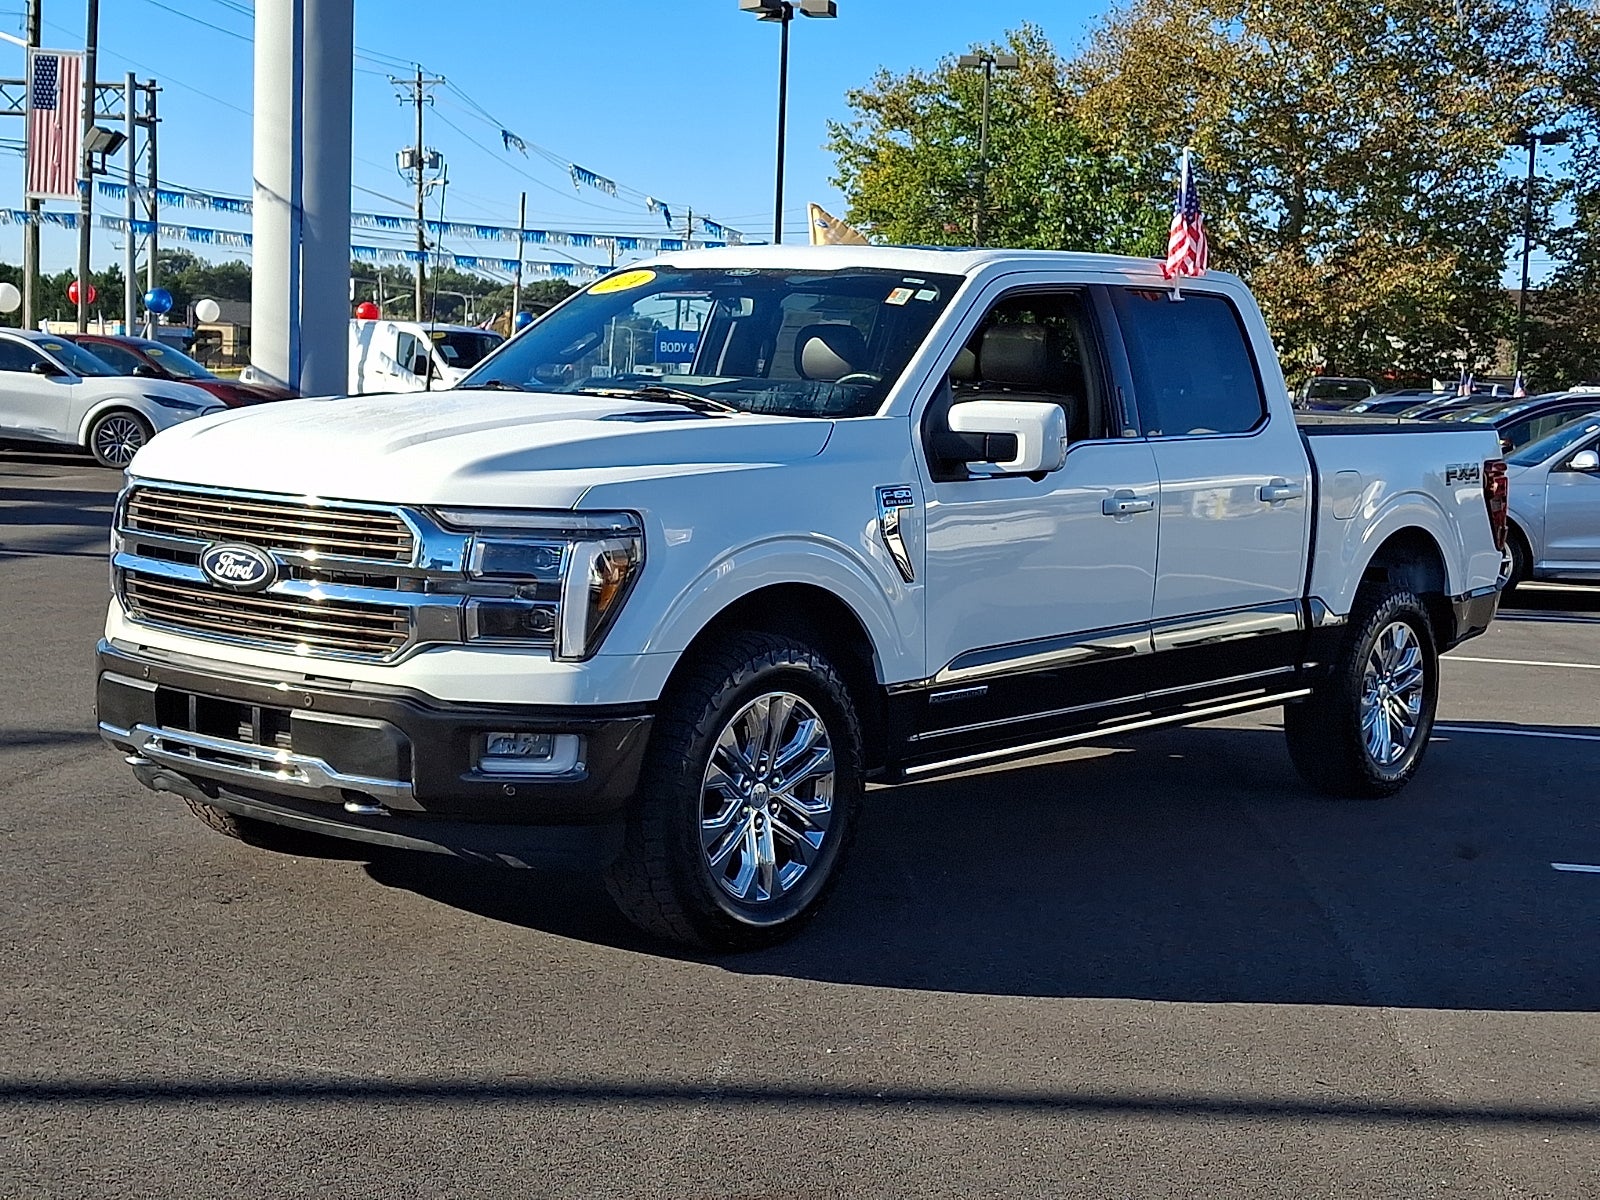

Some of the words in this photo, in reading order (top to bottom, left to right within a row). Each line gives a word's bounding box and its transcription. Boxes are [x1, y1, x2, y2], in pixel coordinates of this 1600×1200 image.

[660, 341, 687, 353] BODY
[688, 343, 695, 353] &
[1445, 463, 1480, 487] FX4
[214, 551, 257, 580] Ford
